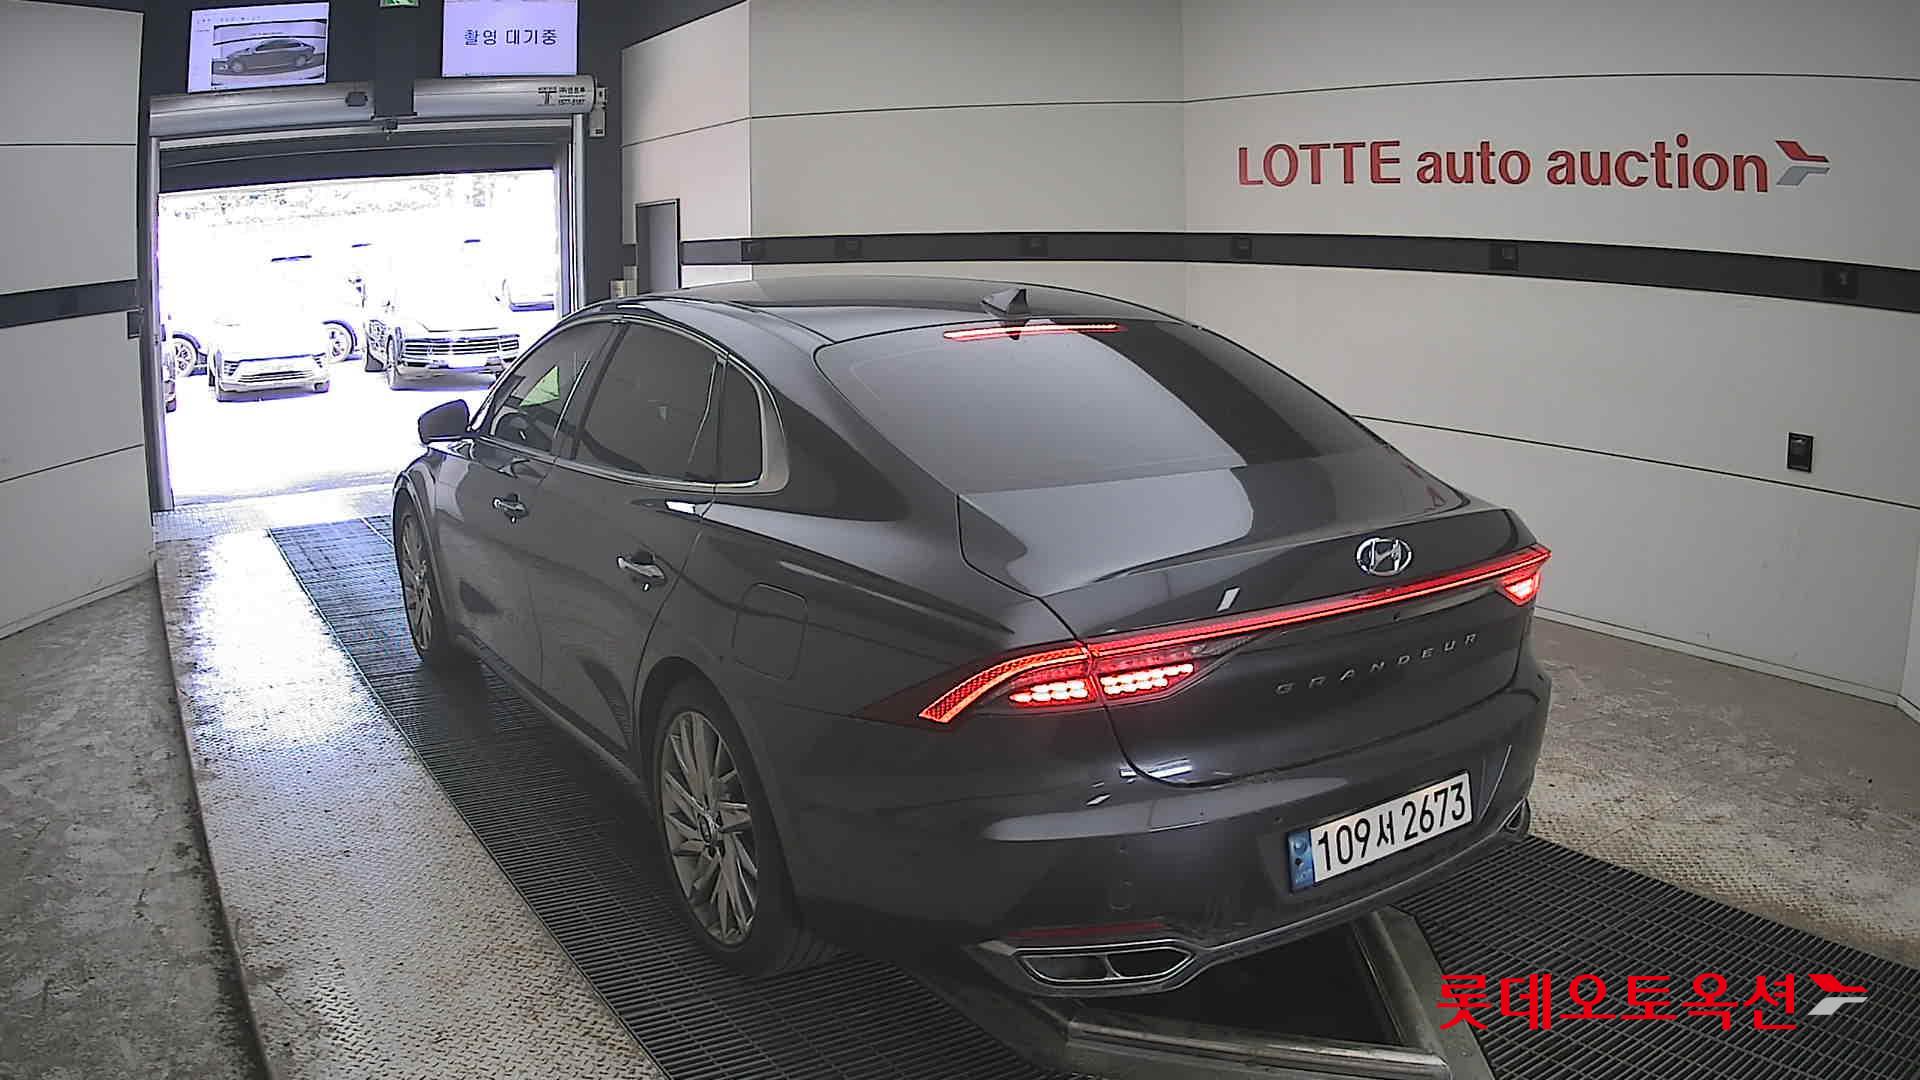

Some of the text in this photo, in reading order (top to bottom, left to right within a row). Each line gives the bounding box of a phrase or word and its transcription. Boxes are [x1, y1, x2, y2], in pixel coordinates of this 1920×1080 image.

[505, 29, 557, 46] 대기중
[1238, 134, 1769, 193] LOTTE auto auction
[1275, 633, 1479, 695] GRANDEUR
